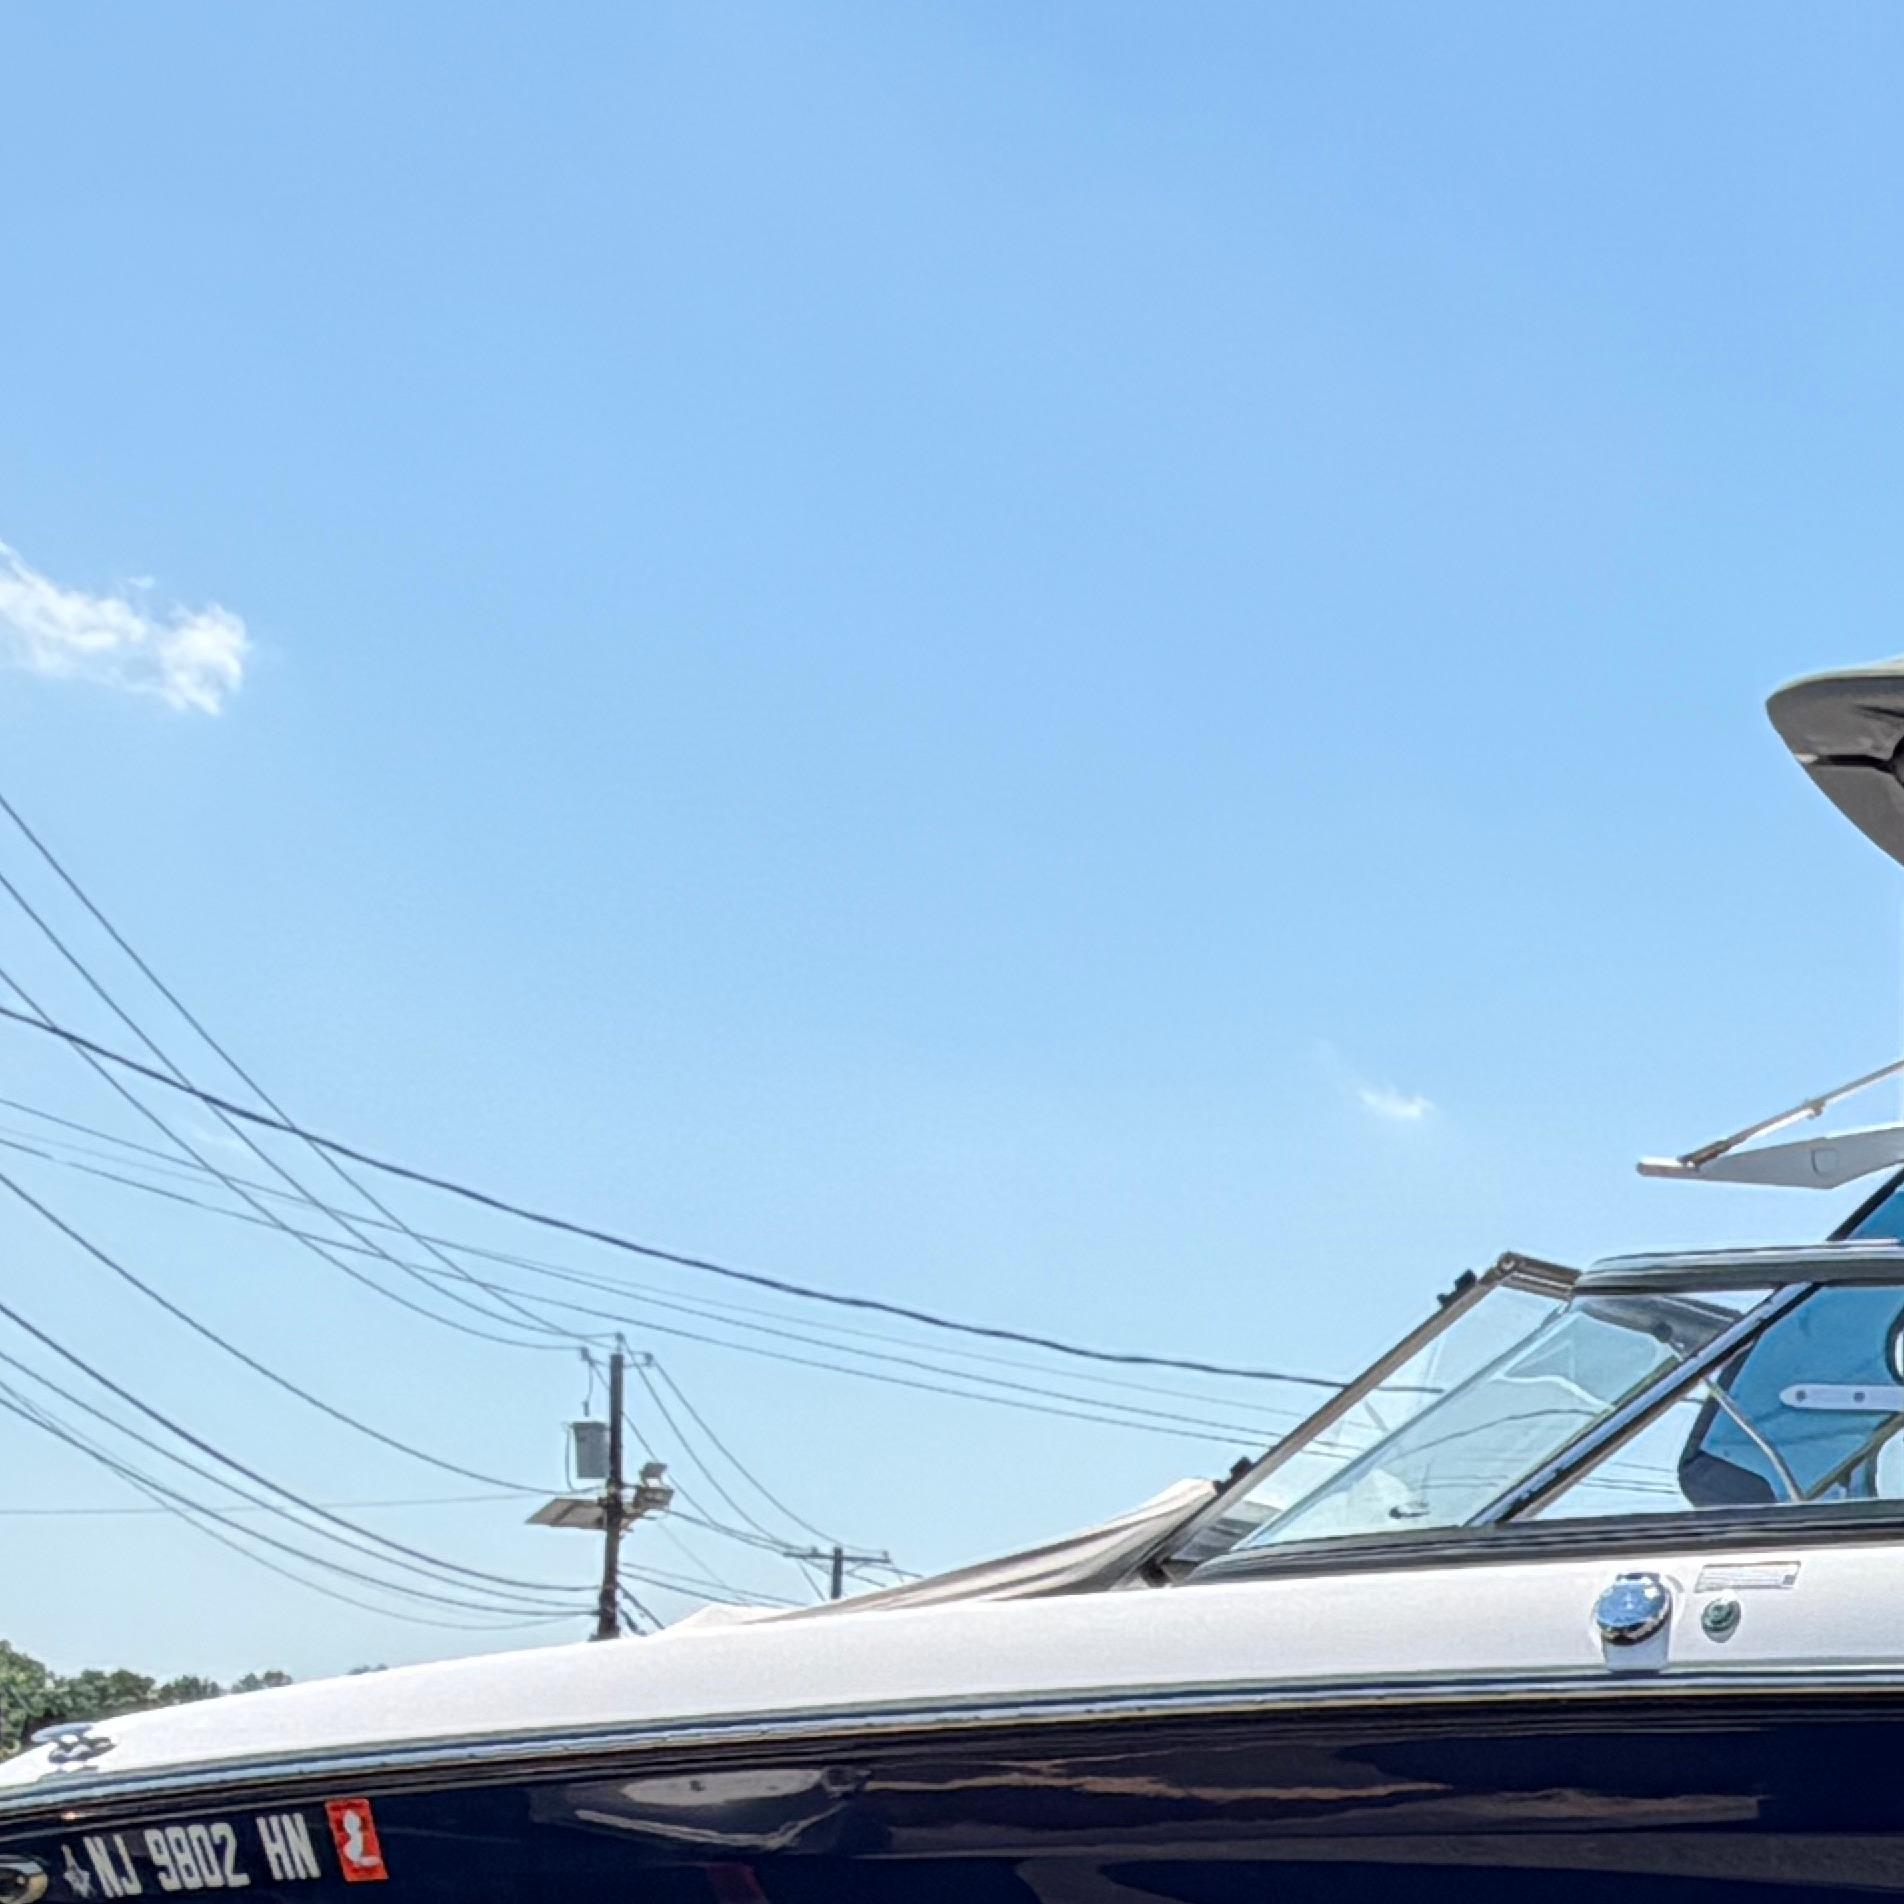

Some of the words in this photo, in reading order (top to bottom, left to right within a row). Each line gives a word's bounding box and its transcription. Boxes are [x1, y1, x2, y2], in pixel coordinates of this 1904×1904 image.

[83, 1833, 142, 1899] NJ
[145, 1822, 251, 1892] 9802
[256, 1812, 321, 1881] HN
